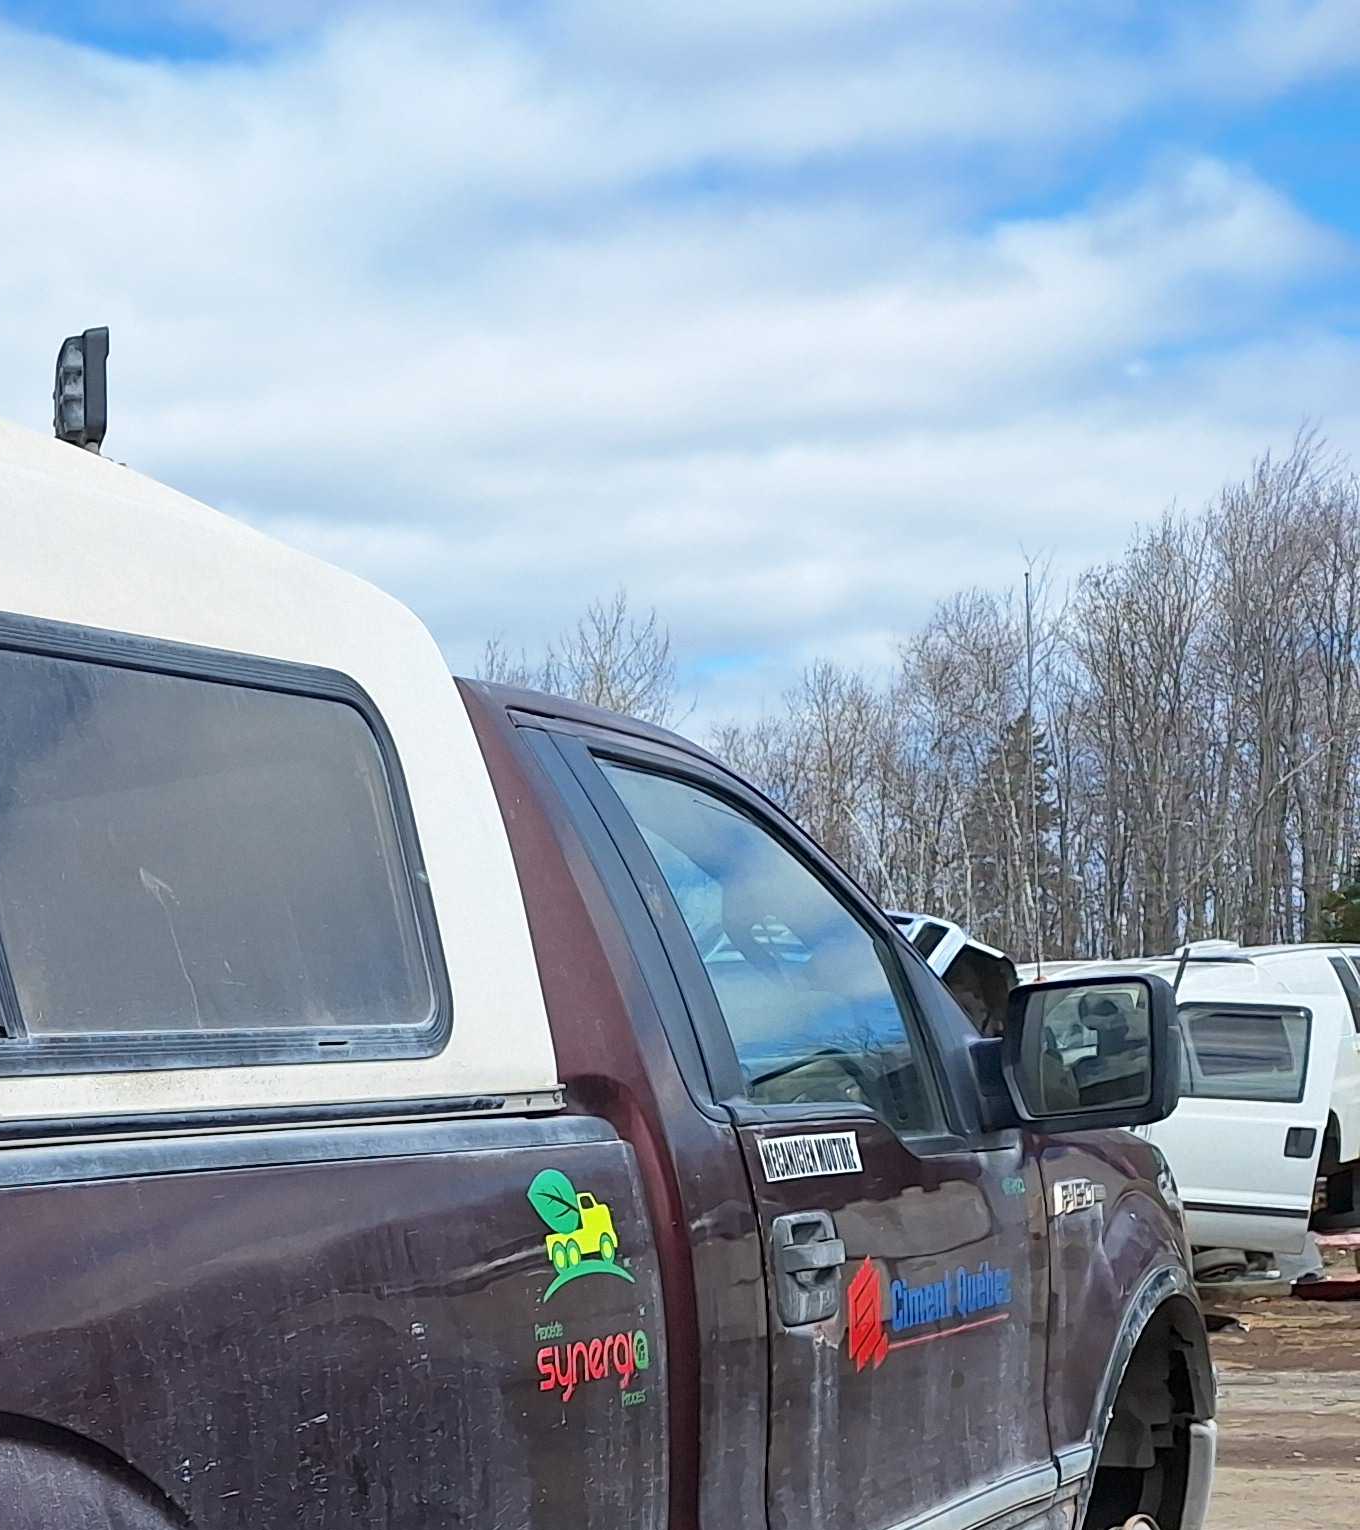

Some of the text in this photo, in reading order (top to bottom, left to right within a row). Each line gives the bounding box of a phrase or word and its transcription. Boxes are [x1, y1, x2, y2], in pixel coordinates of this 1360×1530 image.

[890, 1259, 1014, 1332] Ciment Québec
[536, 1329, 650, 1403] synergia
